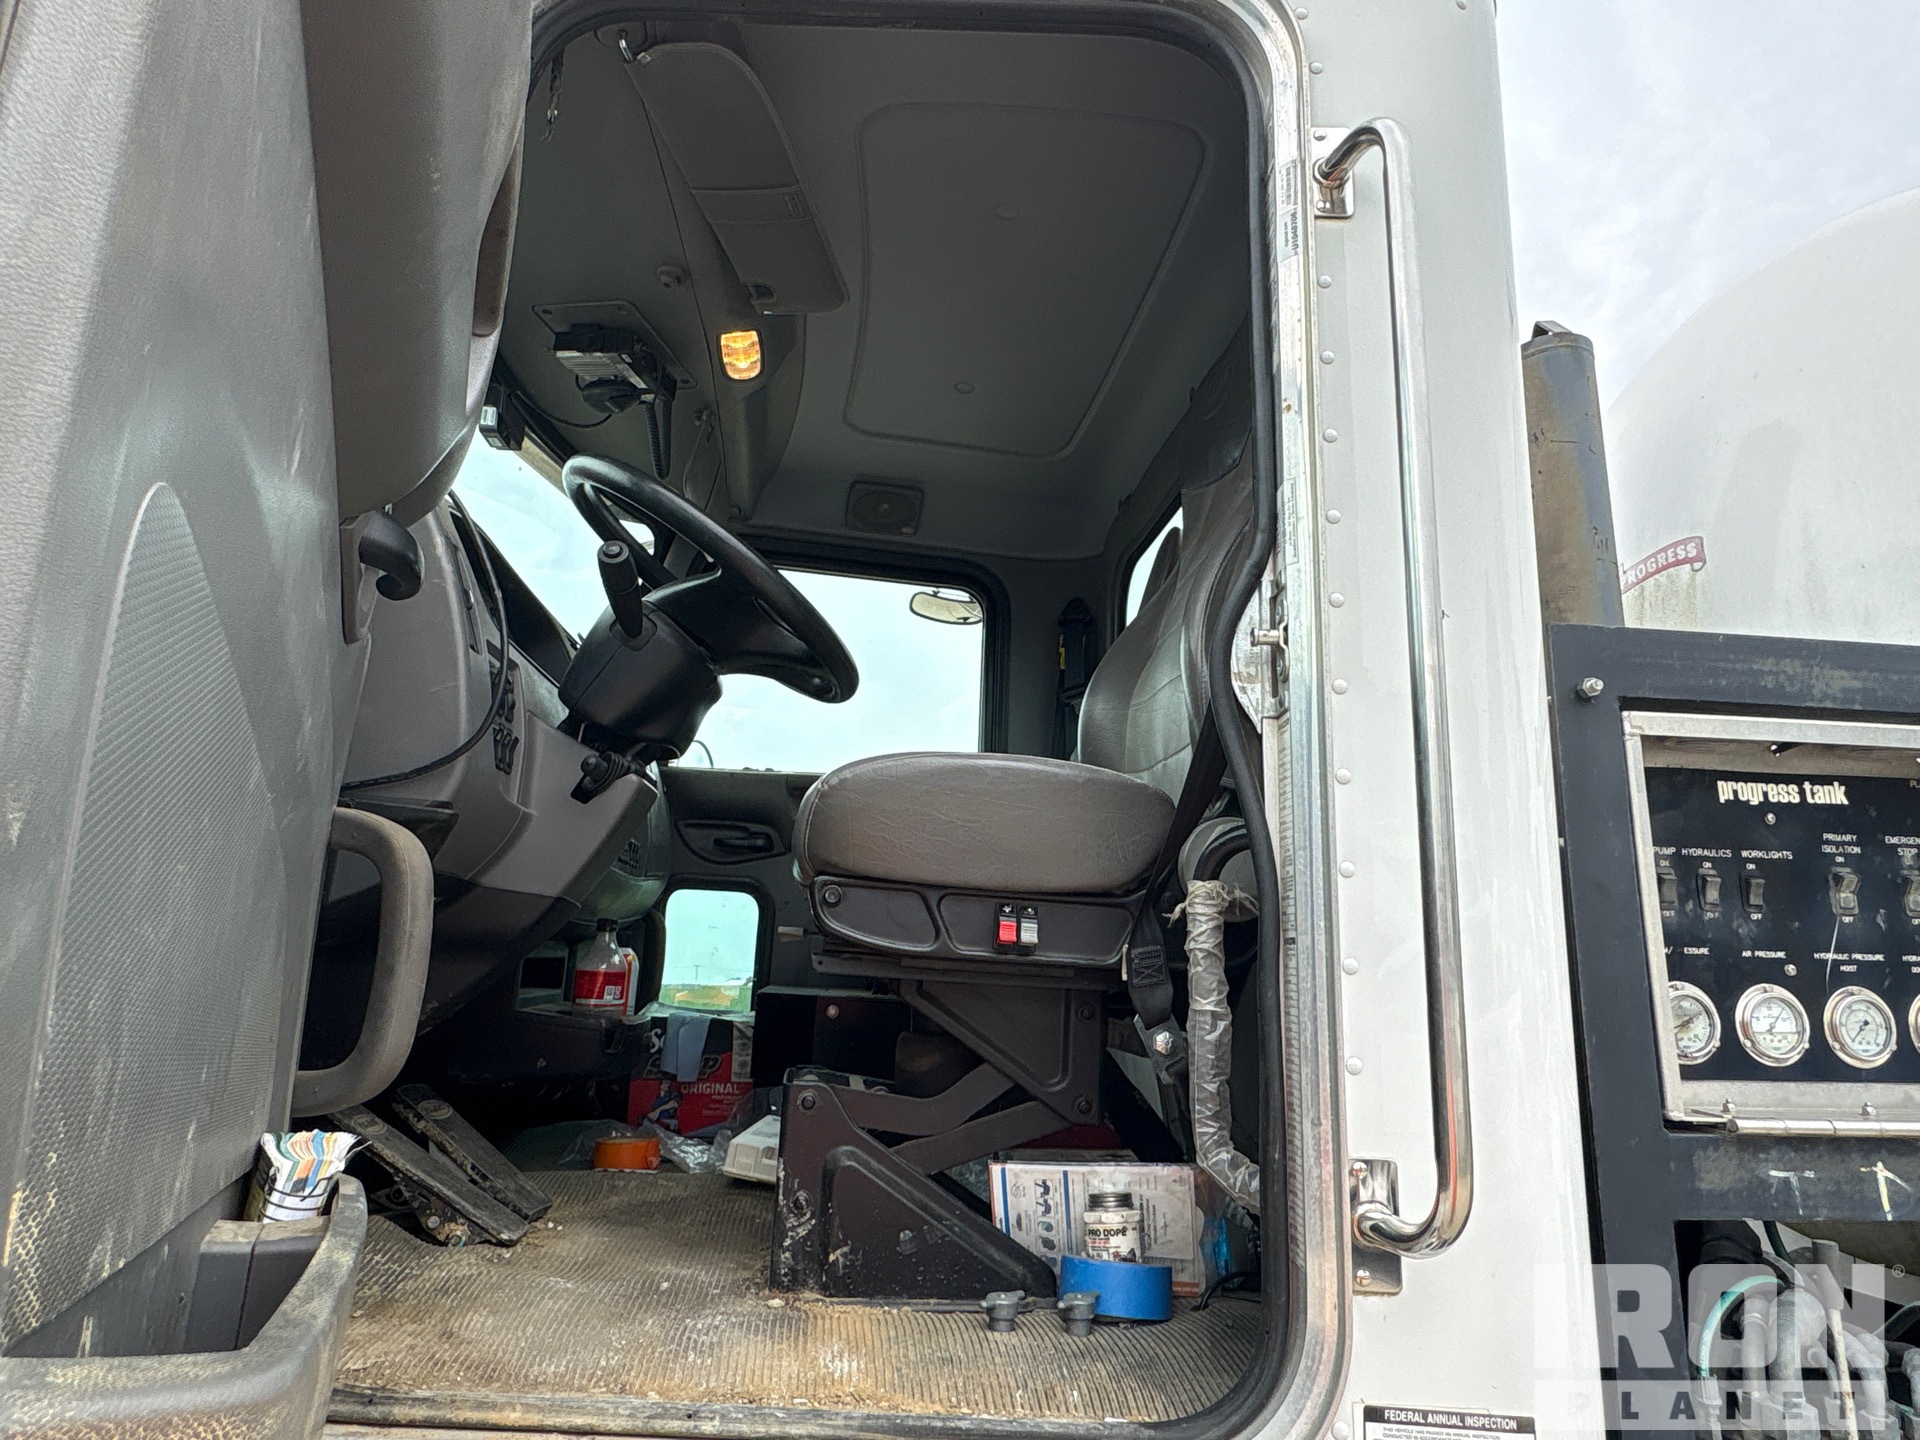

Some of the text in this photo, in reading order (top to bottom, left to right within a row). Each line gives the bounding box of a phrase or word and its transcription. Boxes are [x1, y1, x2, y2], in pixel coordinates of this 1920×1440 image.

[1716, 780, 1850, 805] progress tank
[1822, 832, 1858, 843] PRIMARY
[1681, 847, 1732, 858] HYDRAULICS
[1821, 844, 1862, 854] ISOLATION
[1897, 847, 1918, 857] STOP
[1740, 850, 1794, 860] WORKLIGHTS
[1754, 951, 1787, 959] PRESSURE
[1813, 952, 1886, 961] HYDRAULIC PRESSURE
[681, 1082, 740, 1095] ORIGINAL
[1088, 1228, 1127, 1237] PRO DOPE
[1384, 1409, 1518, 1430] FEDERAL ANNUAL INSPECTION
